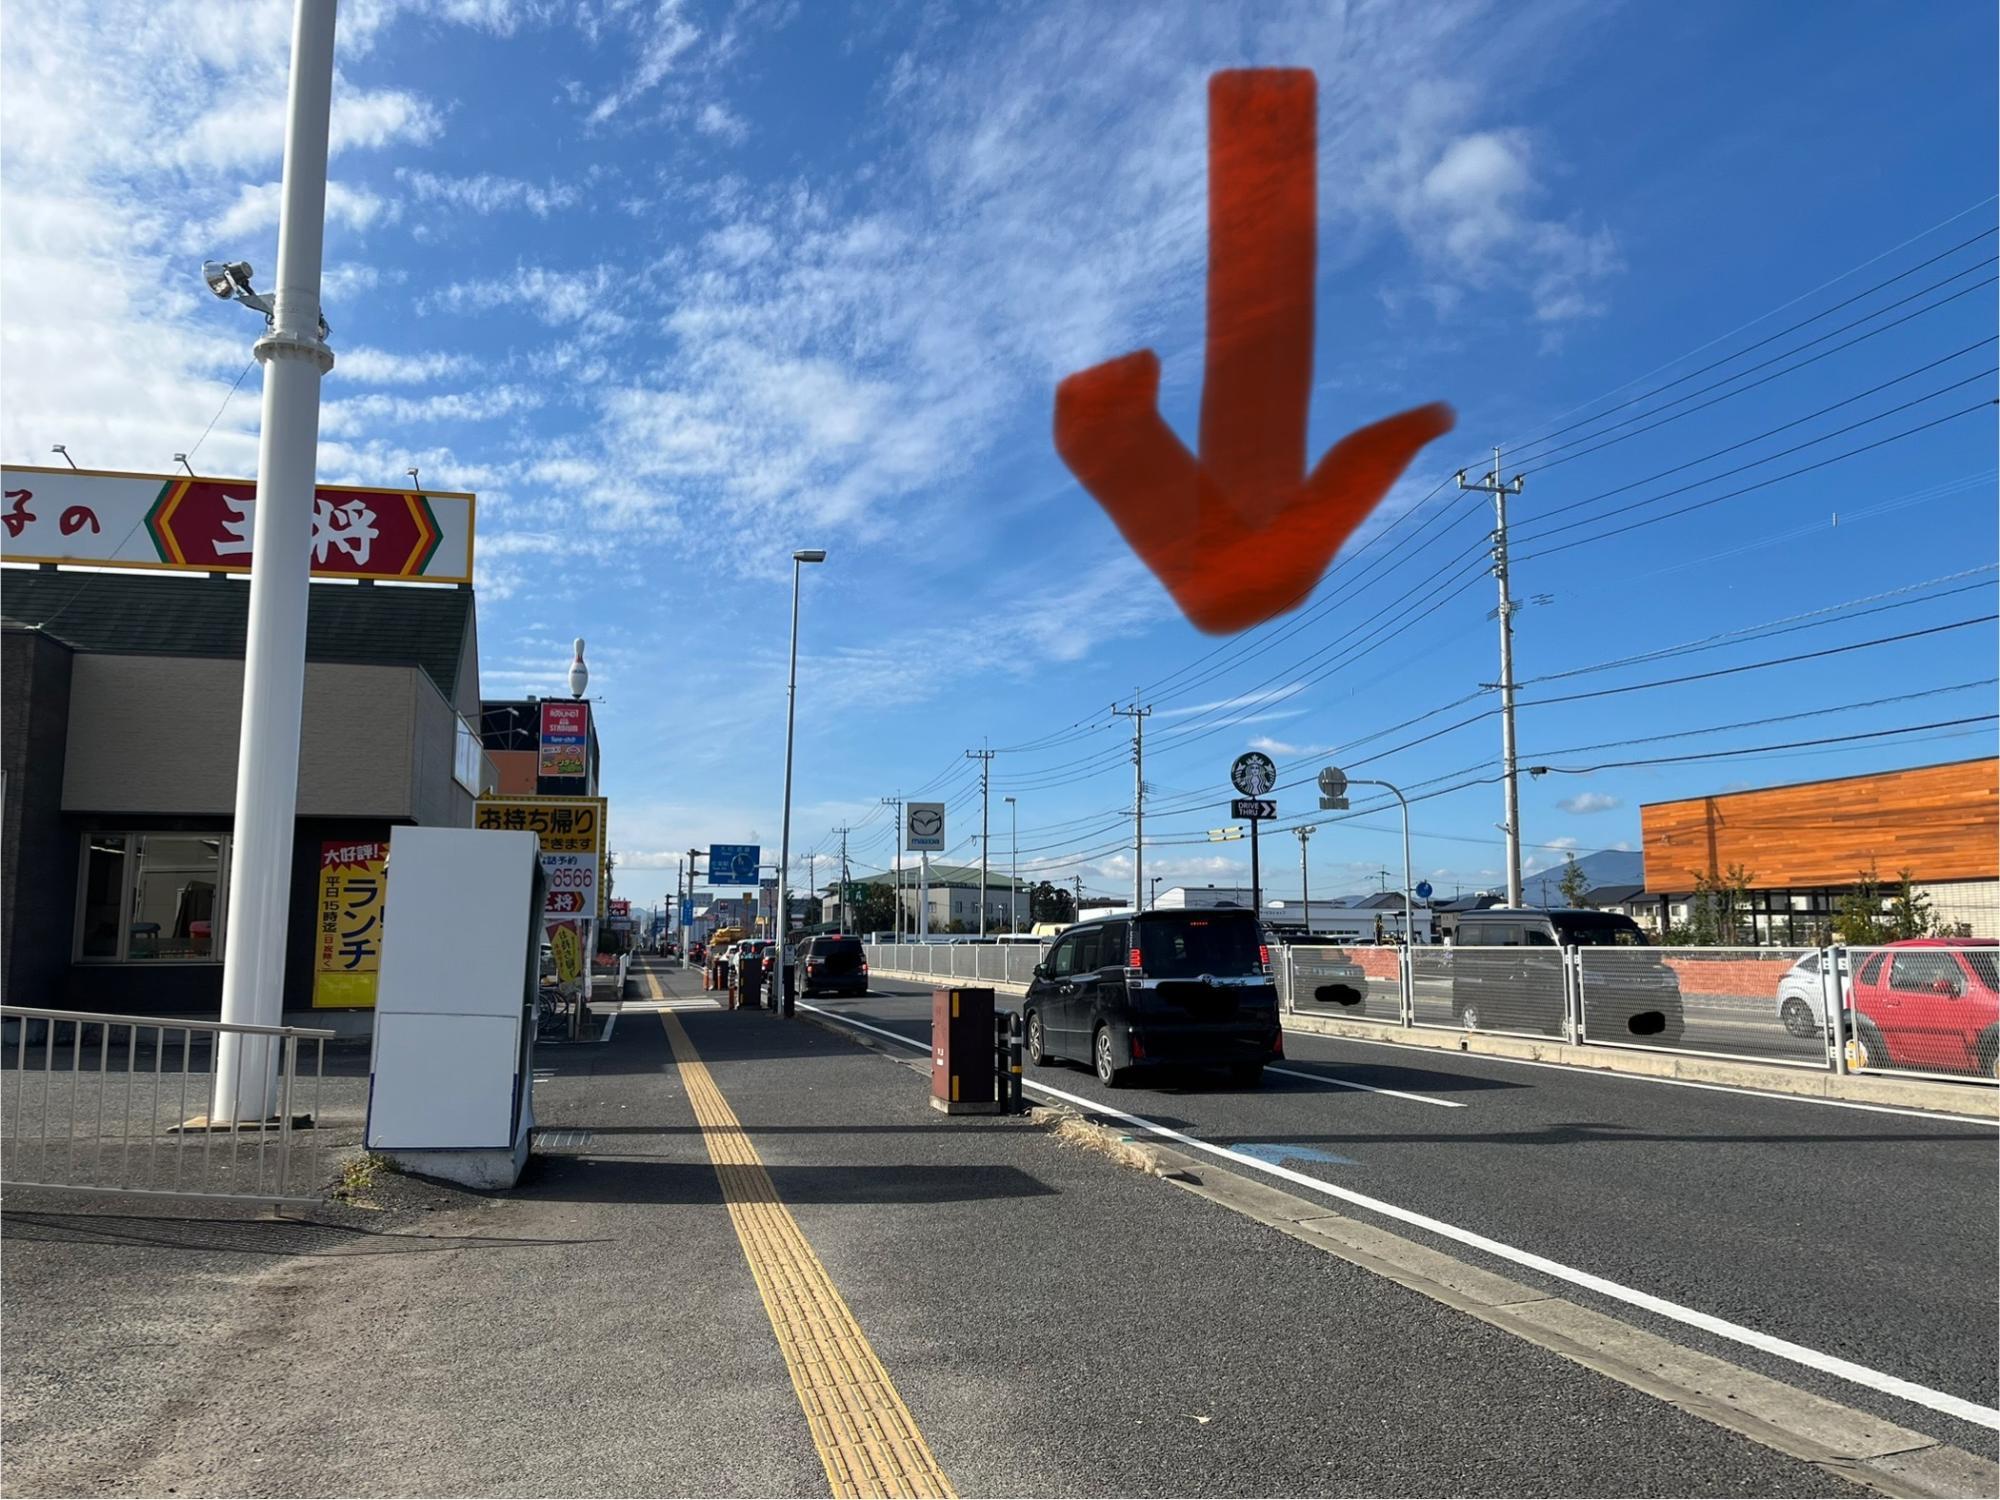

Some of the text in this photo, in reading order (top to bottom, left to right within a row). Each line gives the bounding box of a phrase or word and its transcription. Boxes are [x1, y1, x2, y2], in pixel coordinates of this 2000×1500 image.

[479, 808, 593, 834] お持ち帰り
[553, 868, 593, 888] 6566
[338, 879, 378, 970] ランチ
